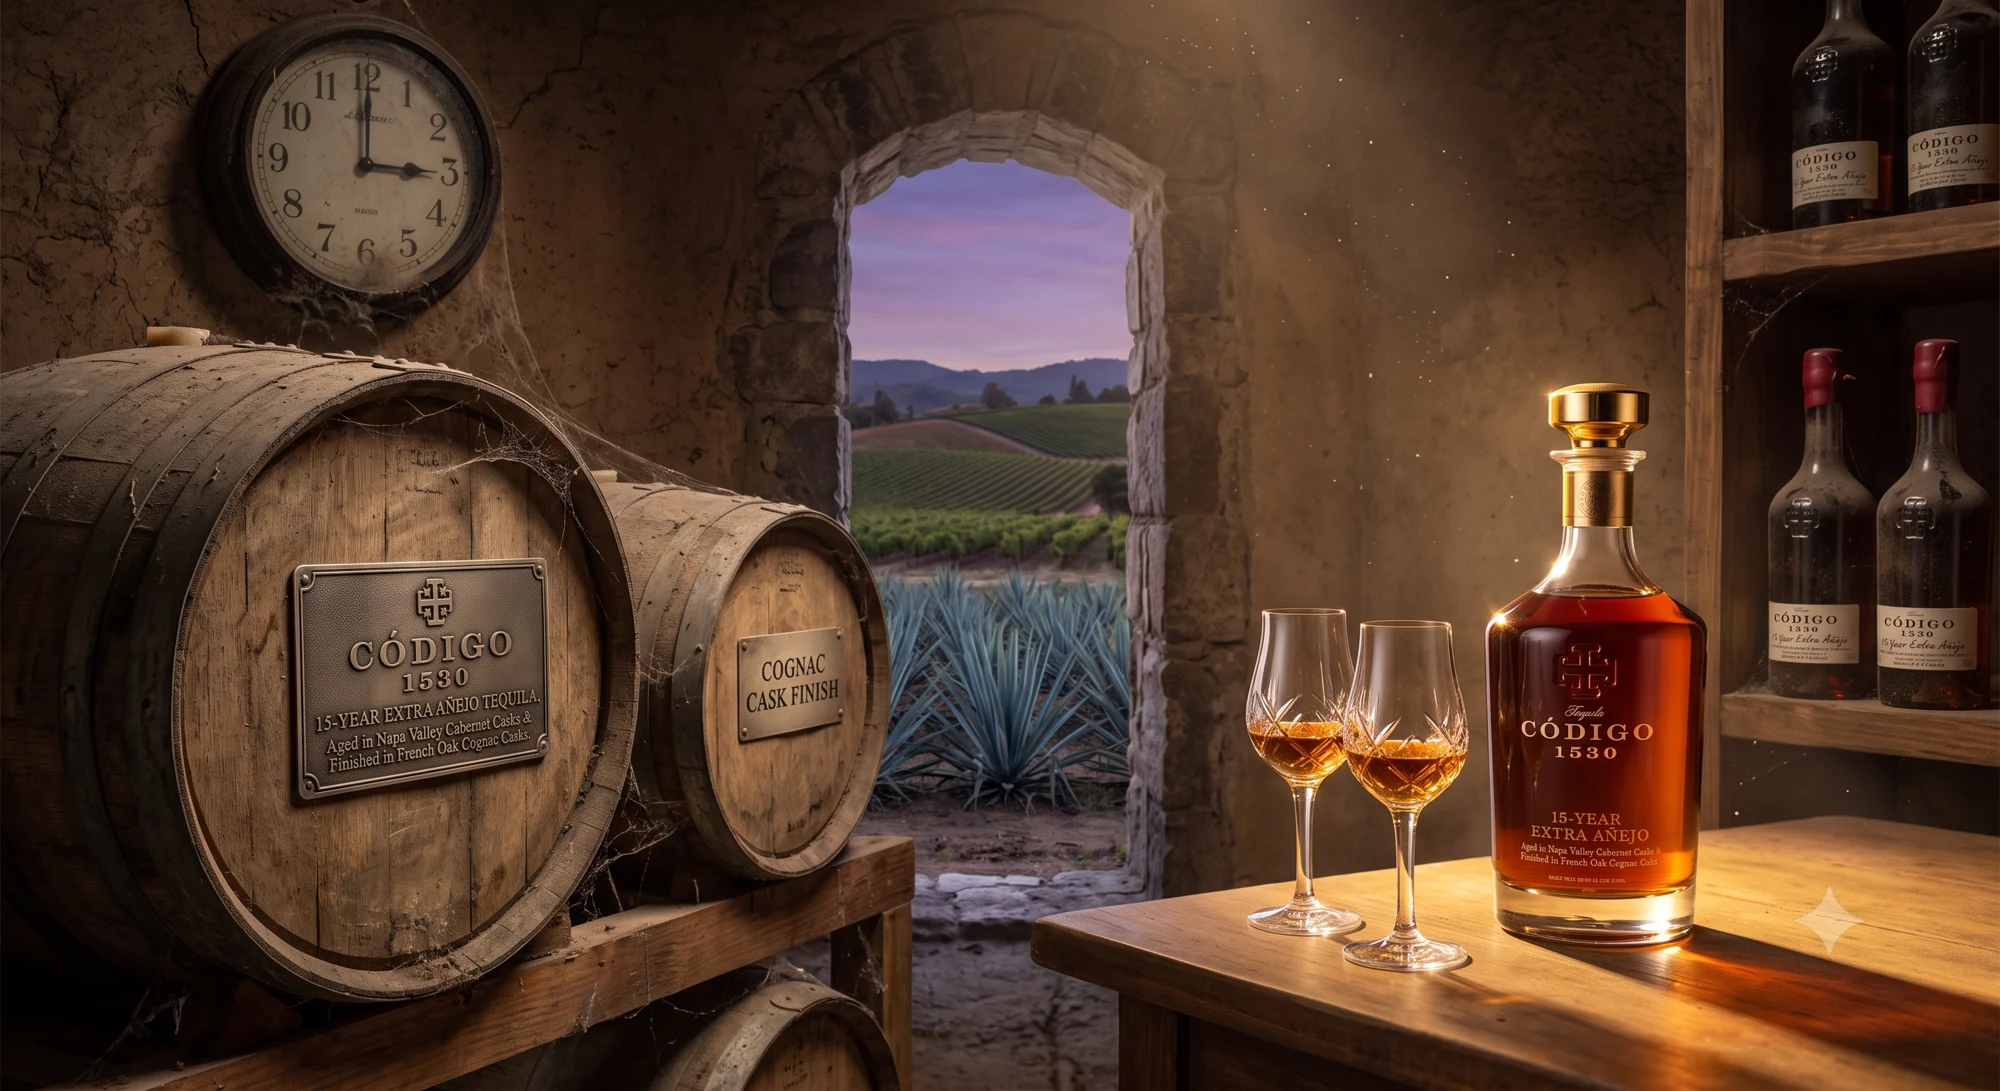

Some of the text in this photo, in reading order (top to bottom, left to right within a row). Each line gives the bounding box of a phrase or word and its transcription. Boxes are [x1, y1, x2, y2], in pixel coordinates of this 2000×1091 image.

[314, 70, 337, 101] 11
[352, 62, 381, 92] 12
[402, 80, 414, 108] 1
[282, 101, 311, 131] 10
[429, 113, 447, 142] 2
[269, 143, 288, 172] 9
[1912, 134, 1979, 153] CÓDIGO
[440, 158, 459, 186] 3
[1796, 151, 1856, 168] CÓDIGO
[283, 189, 303, 218] 8
[425, 199, 447, 227] 4
[317, 223, 336, 252] 7
[399, 228, 418, 257] 5
[357, 238, 376, 267] 6
[1774, 611, 1837, 624] CÓDIGO
[1884, 615, 1954, 630] CÓDIGO
[350, 630, 513, 671] CÓDIGO
[403, 667, 469, 693] 1530
[762, 653, 826, 682] COGNAC
[316, 689, 541, 732] 15-YEAR EXTRA AÑEJO TEQUILA.
[746, 679, 839, 713] CASK FINISH
[327, 710, 532, 757] Aged in Napa Valley Cabernet Casks &
[1521, 716, 1654, 741] CÓDIGO
[329, 750, 380, 774] Finished
[383, 749, 394, 764] in
[397, 743, 434, 762] French
[437, 739, 459, 755] Oak
[462, 734, 499, 752] Cognac
[1554, 745, 1617, 759] 1530
[1551, 811, 1622, 826] 15-YEAR
[1530, 825, 1649, 845] EXTRA AÑEJO
[1520, 852, 1549, 863] Finished
[1551, 855, 1559, 864] in
[1560, 856, 1588, 867] French
[1590, 858, 1608, 867] Oak
[1521, 842, 1538, 852] Aged
[1548, 844, 1568, 856] Napa
[1569, 846, 1594, 858] Valley
[1596, 847, 1632, 857] Cabernet
